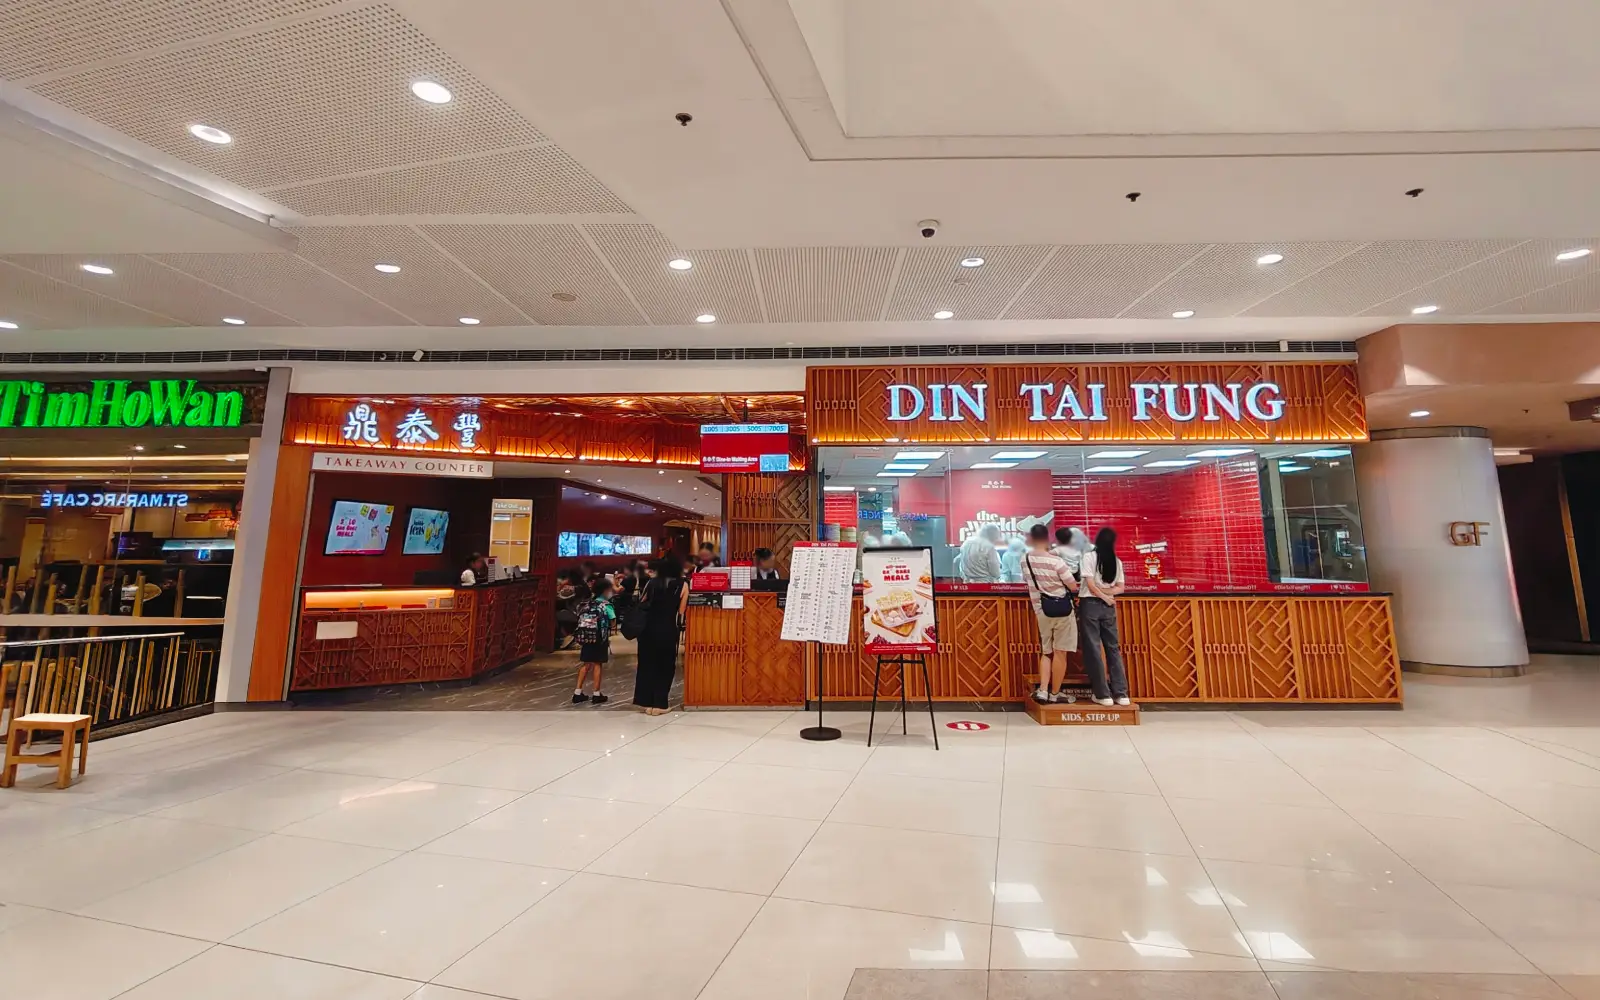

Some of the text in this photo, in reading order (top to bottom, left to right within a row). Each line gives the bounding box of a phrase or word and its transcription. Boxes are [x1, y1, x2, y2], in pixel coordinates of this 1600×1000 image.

[885, 382, 1286, 421] DIN TAI FUNG
[343, 403, 483, 448] 鼎泰豐
[325, 456, 485, 473] TAKEAWAY COUNTER
[976, 510, 999, 521] the
[1448, 521, 1490, 546] GF
[1061, 713, 1120, 723] KIDS, STEP UP
